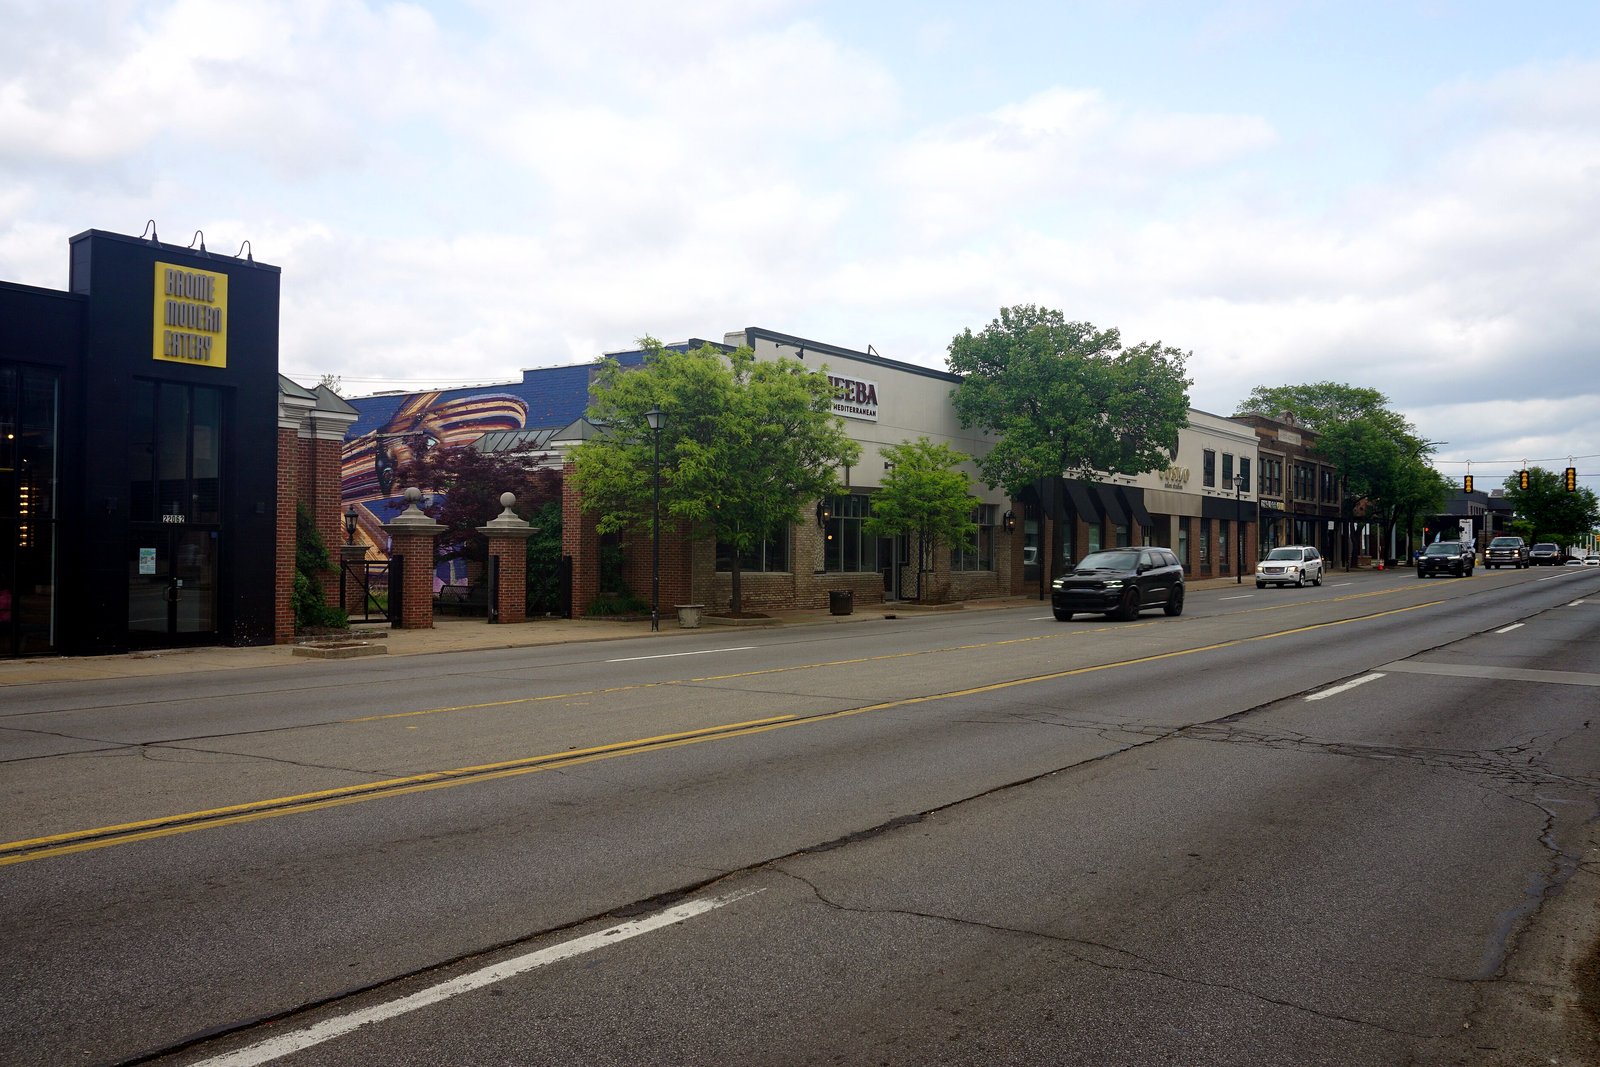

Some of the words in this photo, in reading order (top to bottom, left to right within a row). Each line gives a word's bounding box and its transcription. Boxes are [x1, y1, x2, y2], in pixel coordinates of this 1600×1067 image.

[165, 268, 215, 303] BROME
[164, 299, 222, 333] MODERN
[163, 330, 212, 361] EATERY
[833, 403, 877, 417] MEDITERRANEAN
